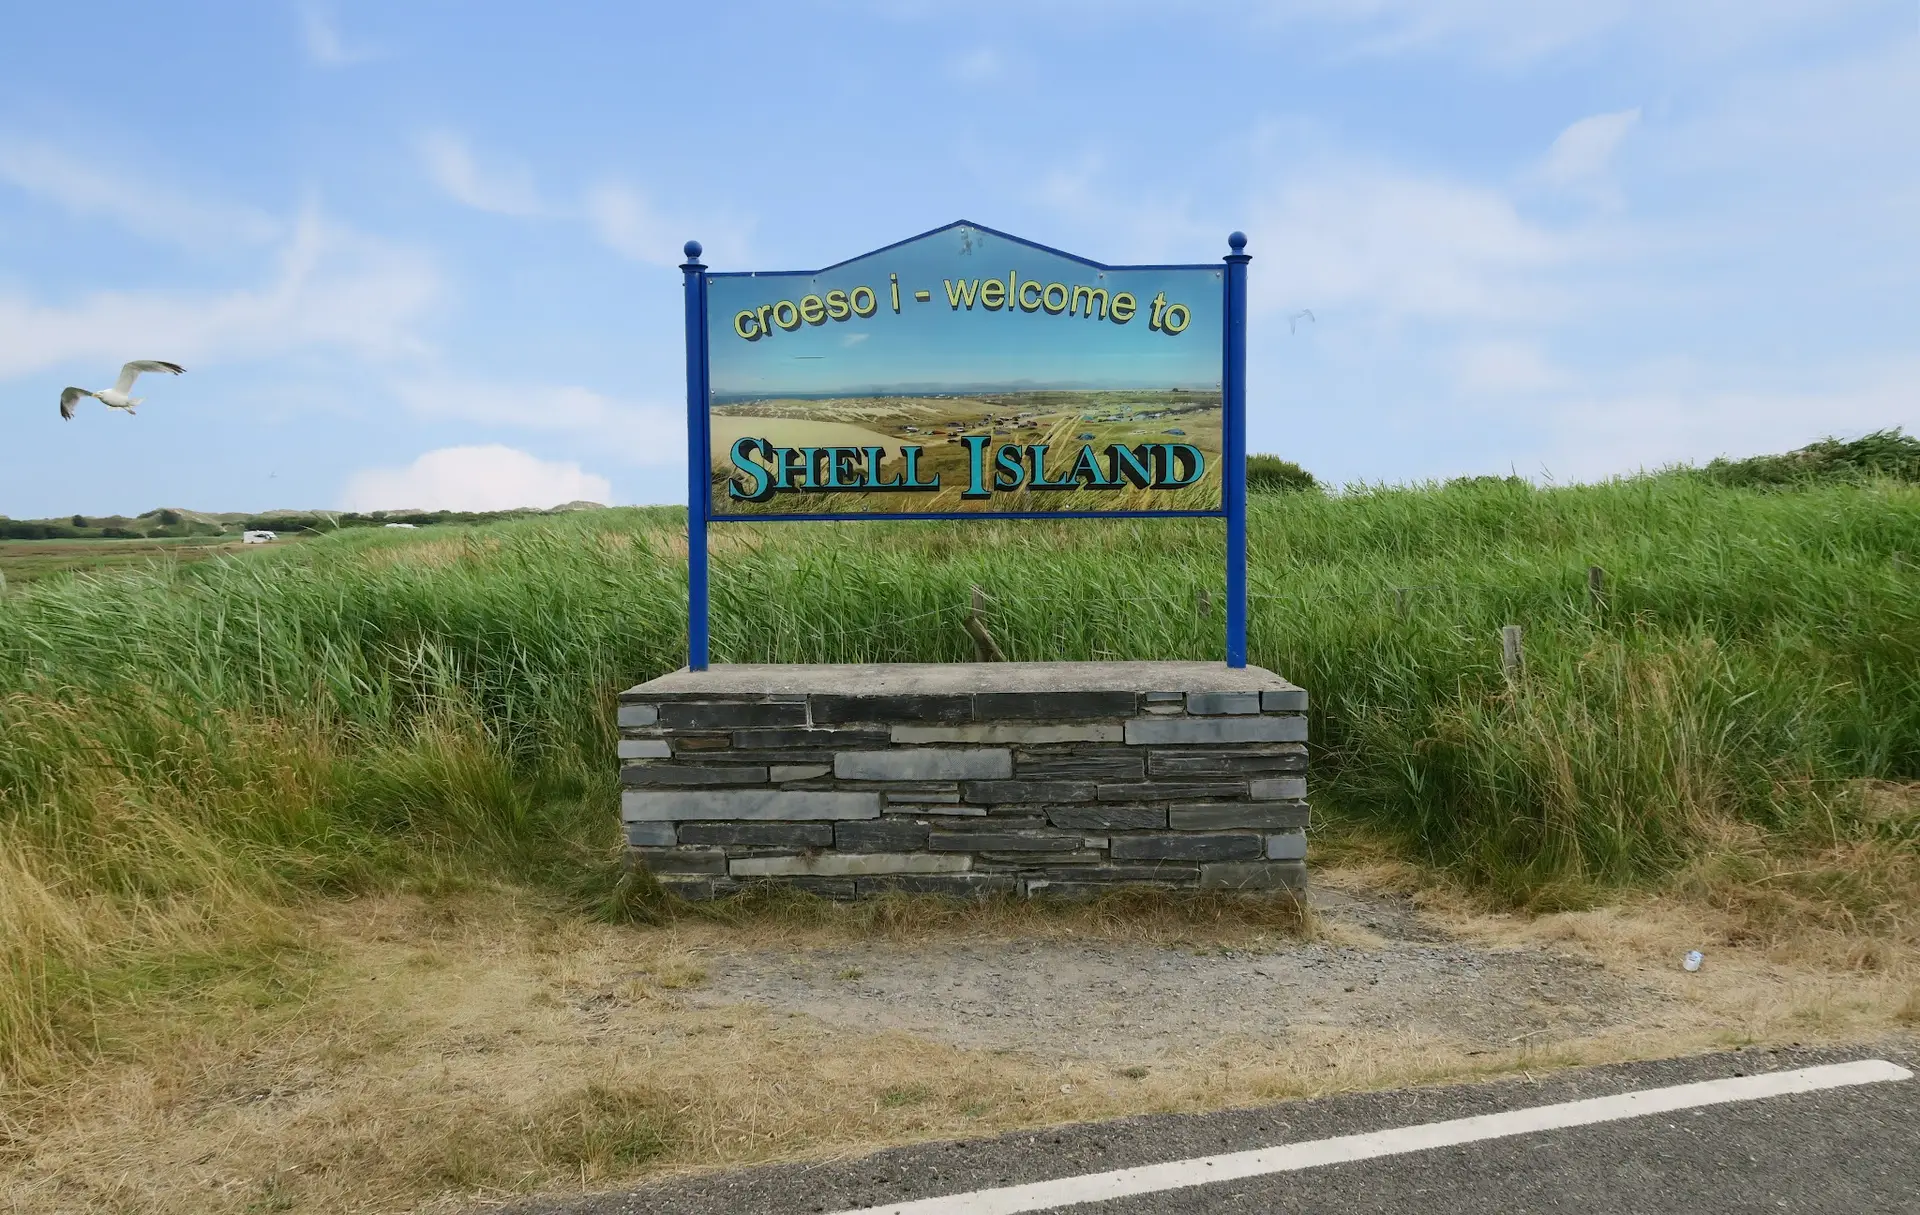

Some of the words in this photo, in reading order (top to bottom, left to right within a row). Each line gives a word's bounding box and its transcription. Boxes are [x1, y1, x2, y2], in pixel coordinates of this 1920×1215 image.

[734, 286, 877, 341] croeso
[890, 273, 900, 314] i
[943, 270, 1137, 324] welcome
[1149, 291, 1191, 336] to
[729, 437, 940, 502] SHELL
[961, 435, 1206, 500] ISLAND
